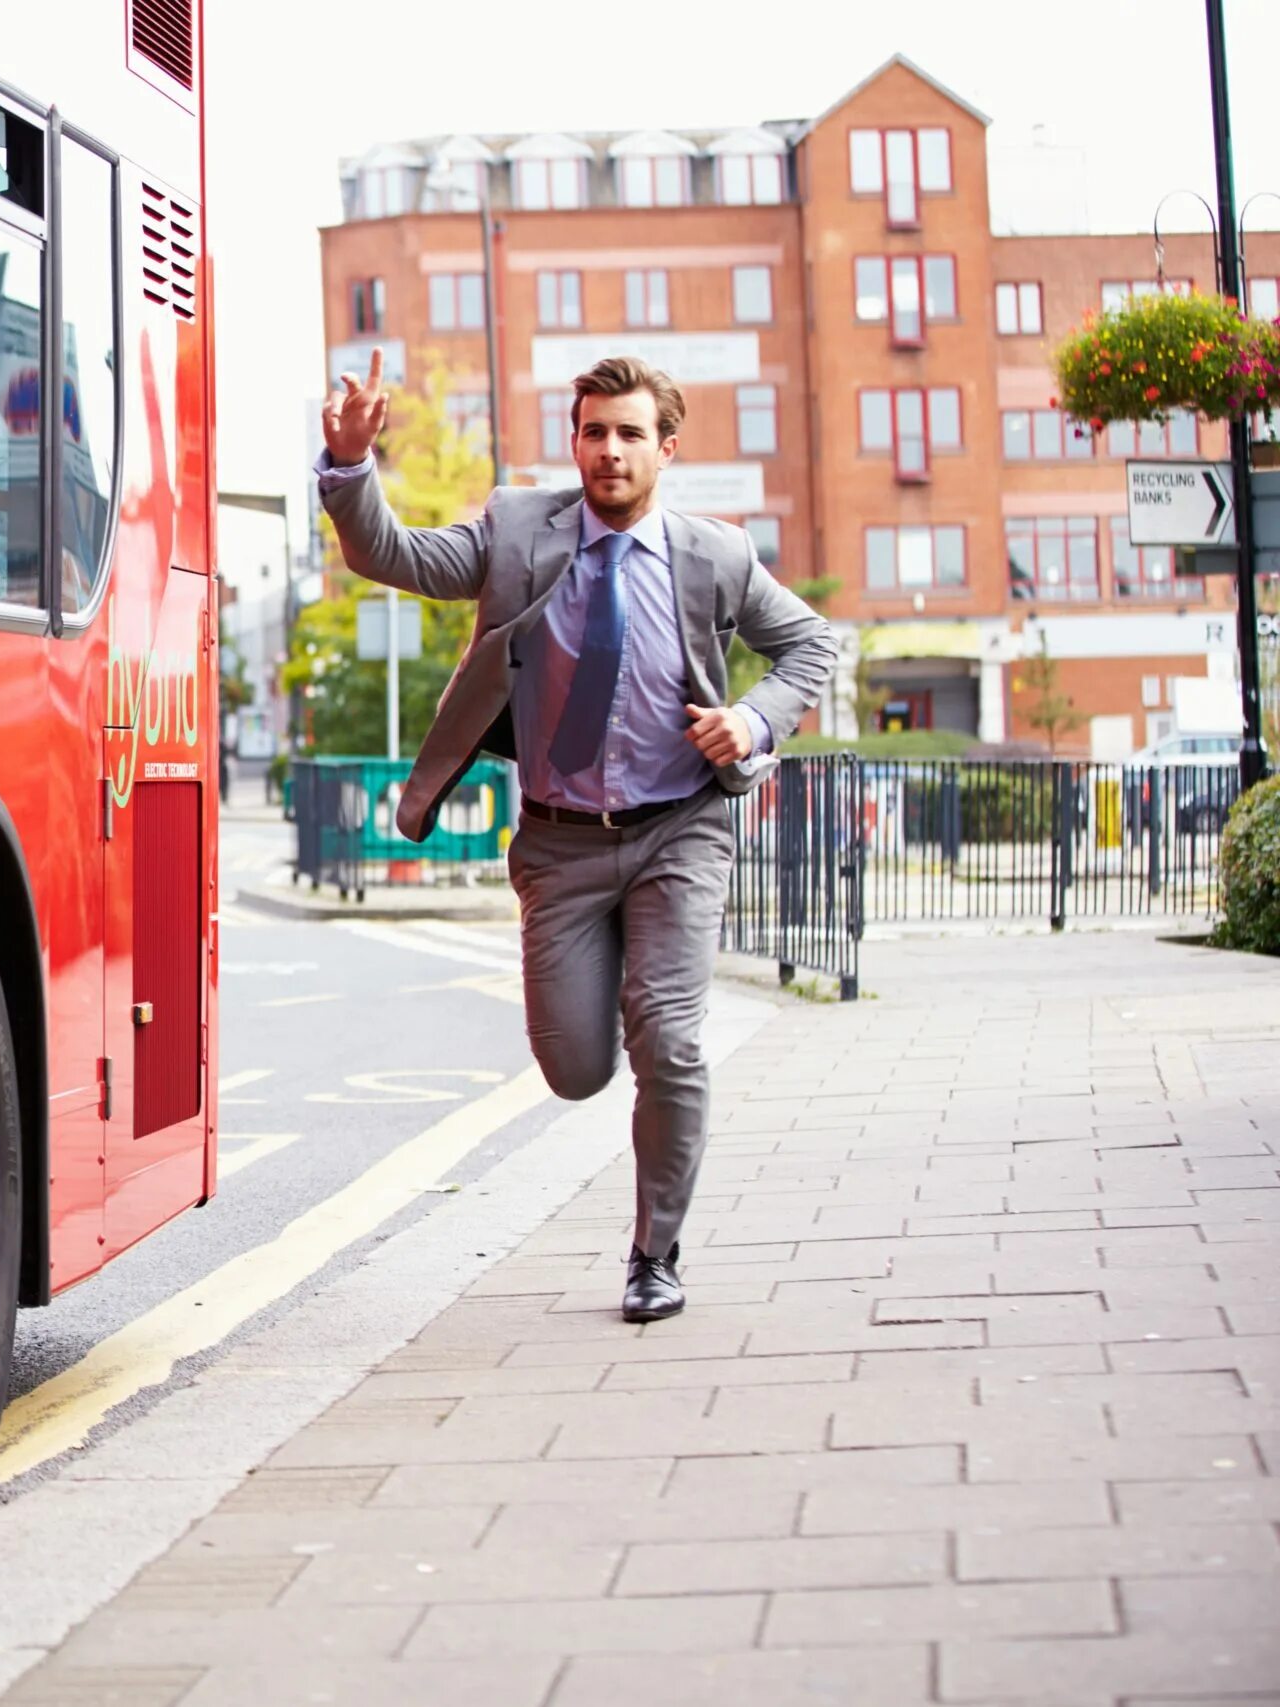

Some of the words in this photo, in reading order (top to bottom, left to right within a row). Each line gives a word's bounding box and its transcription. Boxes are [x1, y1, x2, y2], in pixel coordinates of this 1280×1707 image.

[1132, 471, 1196, 488] RECYCLING
[1133, 491, 1173, 506] BANKS
[144, 762, 168, 778] ELECTRIC
[168, 762, 199, 778] TECHNOLOGY
